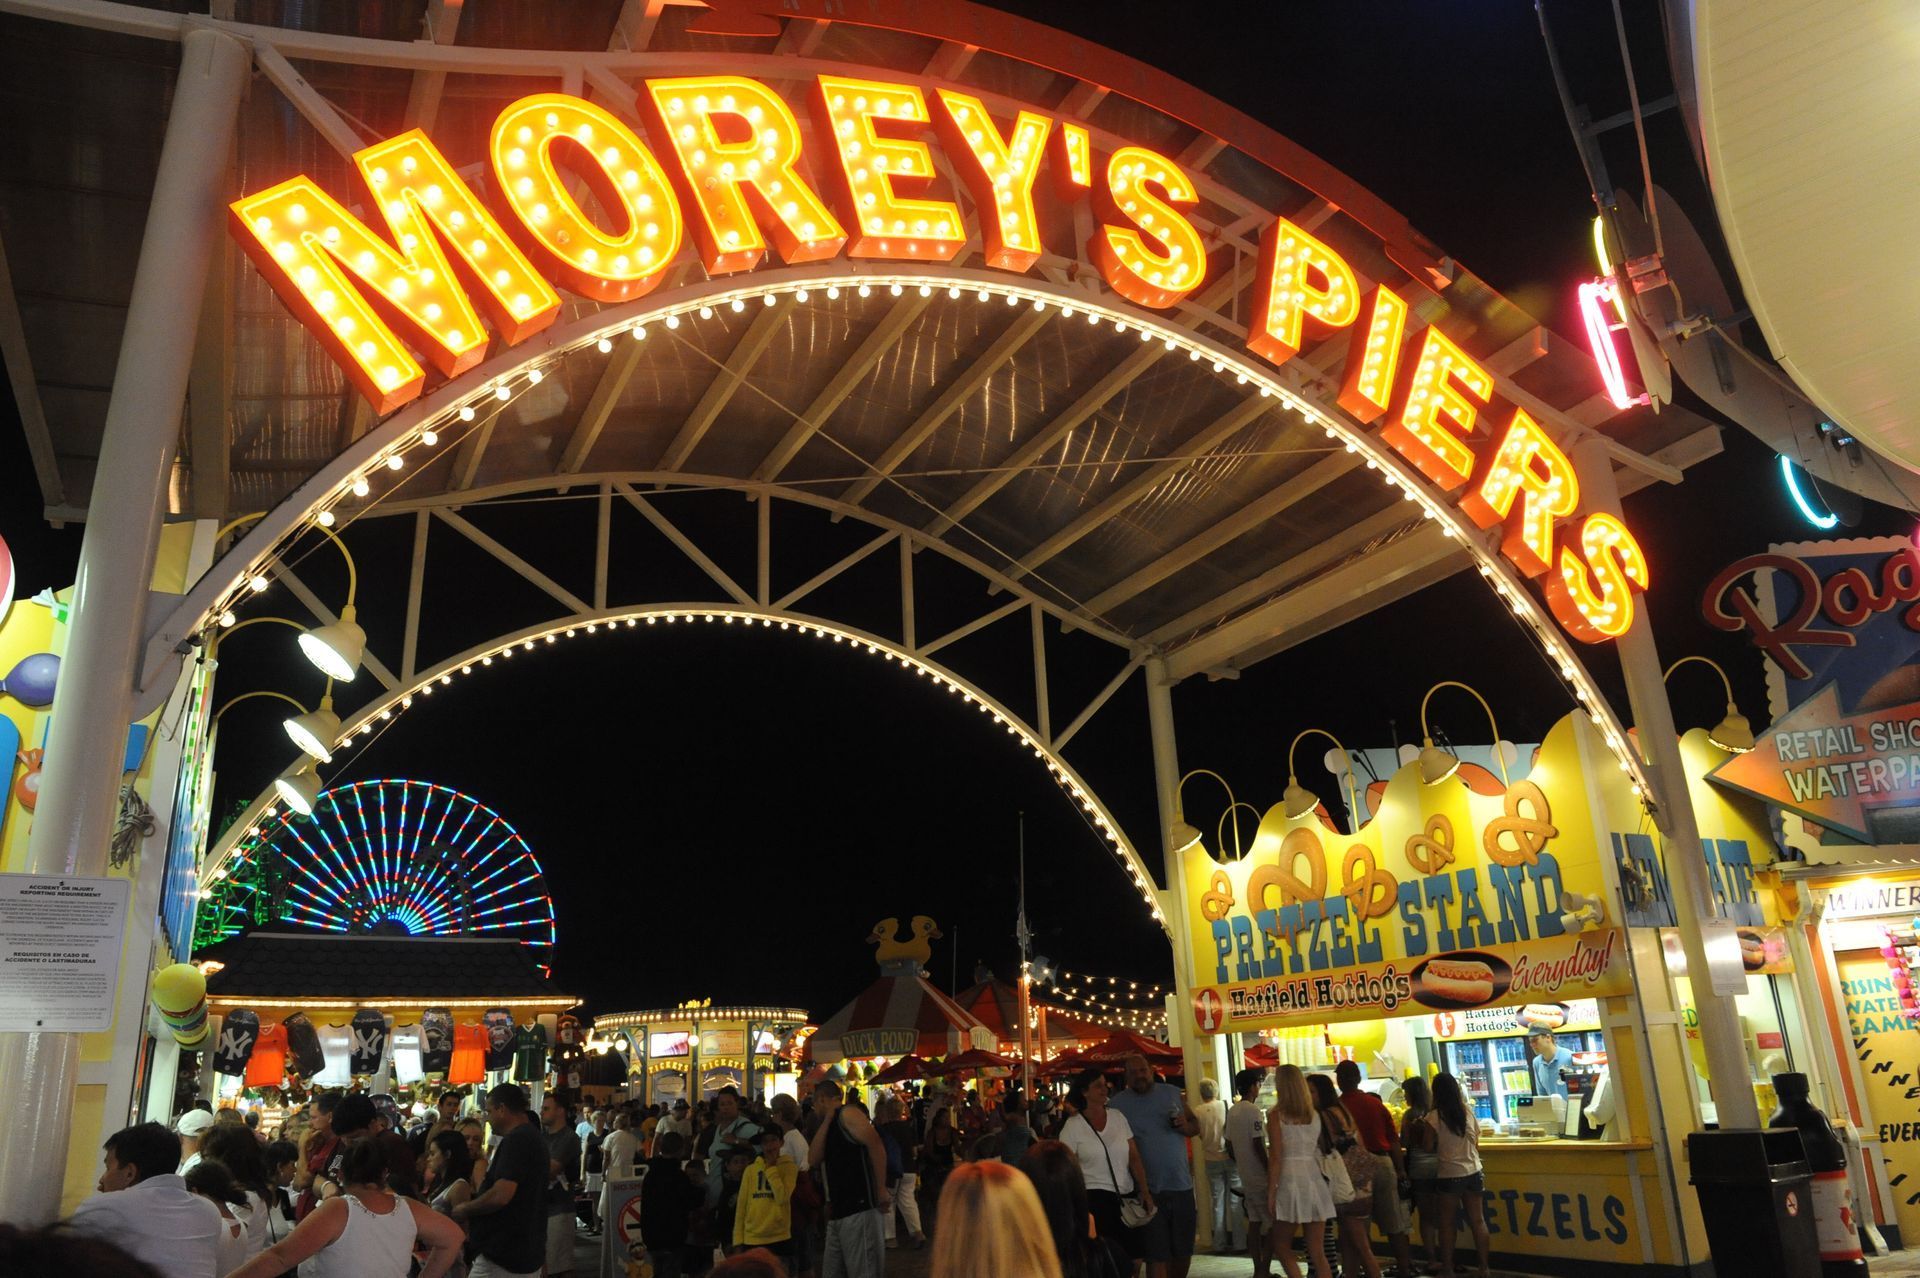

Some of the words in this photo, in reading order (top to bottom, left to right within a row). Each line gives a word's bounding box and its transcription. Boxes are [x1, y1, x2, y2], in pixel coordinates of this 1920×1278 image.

[229, 73, 1207, 415] MOREY'S
[1249, 216, 1649, 644] PIERS
[1776, 725, 1864, 762] RETAIL
[1212, 895, 1384, 985] PRETZEL
[1398, 853, 1566, 958] STAND
[1230, 982, 1311, 1017] Hatfield
[1314, 967, 1411, 1010] Hotdogs
[1512, 931, 1614, 992] Everyday!
[1841, 977, 1895, 996] RISIN
[1465, 1006, 1515, 1019] Hatfield
[1466, 1018, 1518, 1033] Hotdogs
[842, 1032, 877, 1056] DUCK
[880, 1031, 915, 1054] POND
[649, 1060, 689, 1074] TICKETS
[702, 1058, 745, 1071] TICKETS
[754, 1058, 774, 1070] TICKETS
[1457, 1190, 1628, 1245] ETZELS
